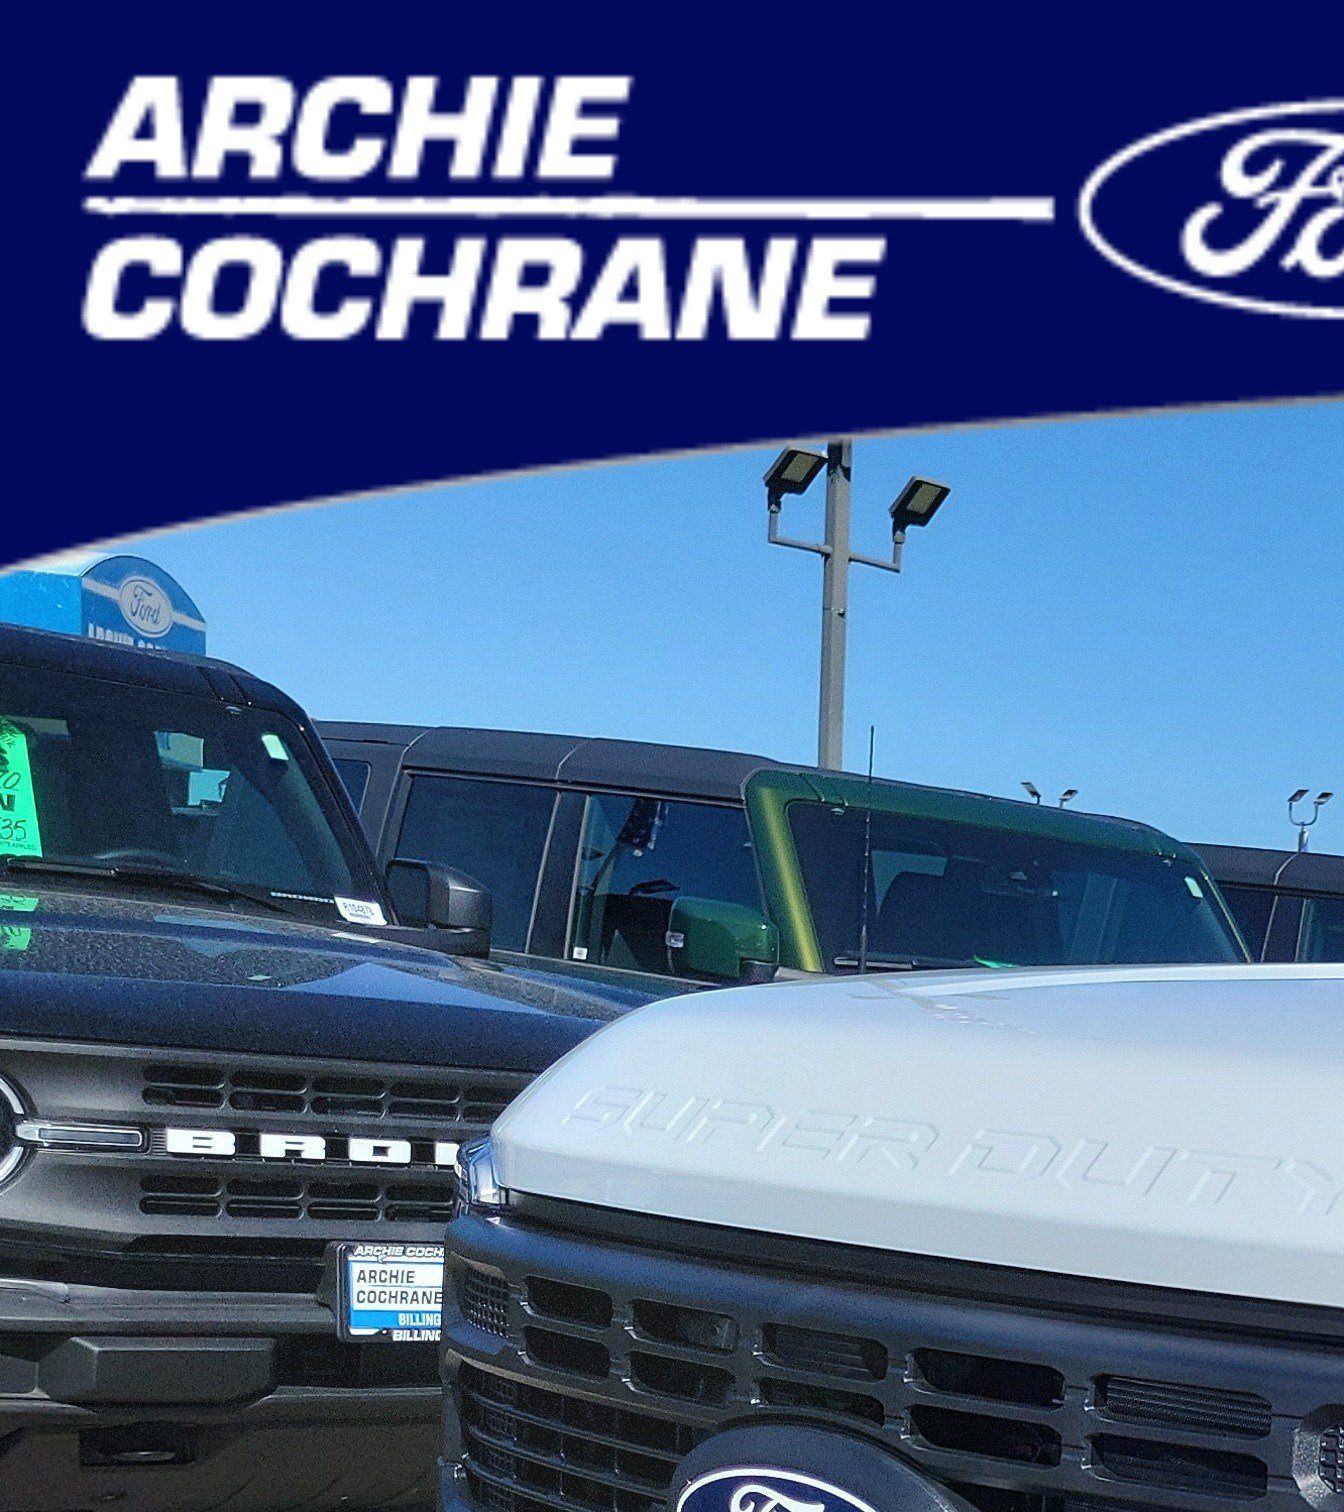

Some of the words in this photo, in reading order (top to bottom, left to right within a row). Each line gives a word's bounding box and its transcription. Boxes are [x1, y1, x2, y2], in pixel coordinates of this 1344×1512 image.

[130, 584, 161, 626] Ford
[561, 1086, 941, 1172] SUPER
[354, 1246, 404, 1256] ARCHIE
[406, 1247, 444, 1257] COCH
[356, 1270, 415, 1284] ARCHIE
[356, 1290, 442, 1305] COCHRANE
